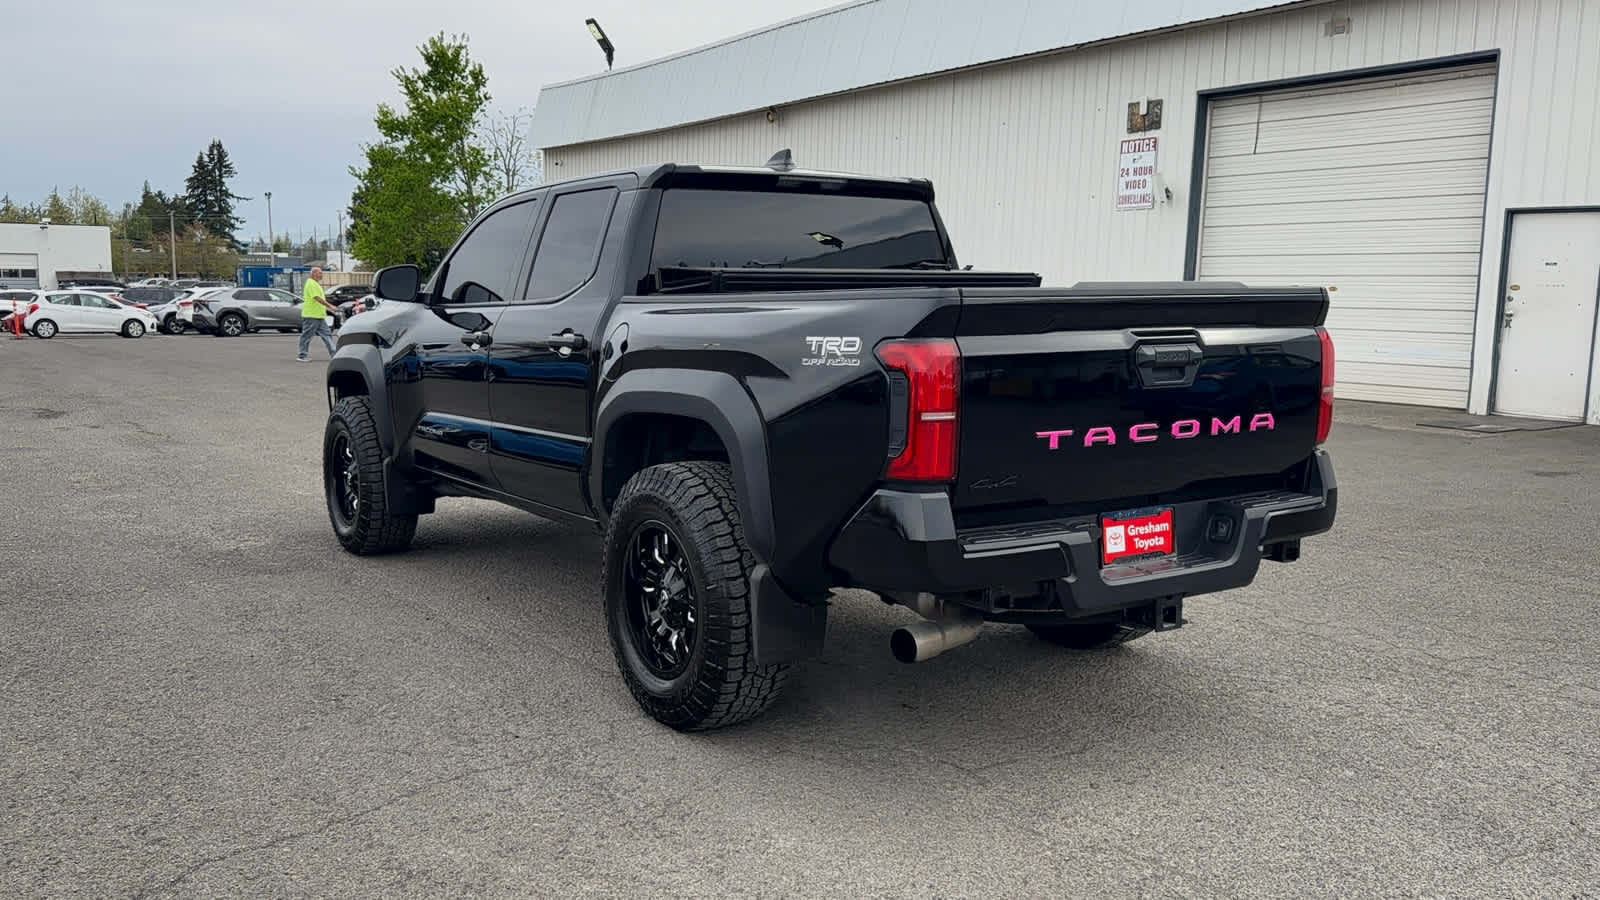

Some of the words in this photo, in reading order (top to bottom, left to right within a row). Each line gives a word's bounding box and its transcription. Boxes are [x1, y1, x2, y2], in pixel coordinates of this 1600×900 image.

[1121, 138, 1157, 153] NOTICE
[1120, 167, 1130, 178] 24
[1132, 165, 1153, 176] HOUR
[1125, 178, 1147, 190] VIDEO
[805, 336, 862, 357] TRD
[801, 358, 825, 366] OFF
[826, 357, 861, 366] ROAD
[1036, 413, 1275, 449] TACOMA
[1127, 521, 1169, 536] Gresham
[1133, 536, 1165, 550] Toyota
